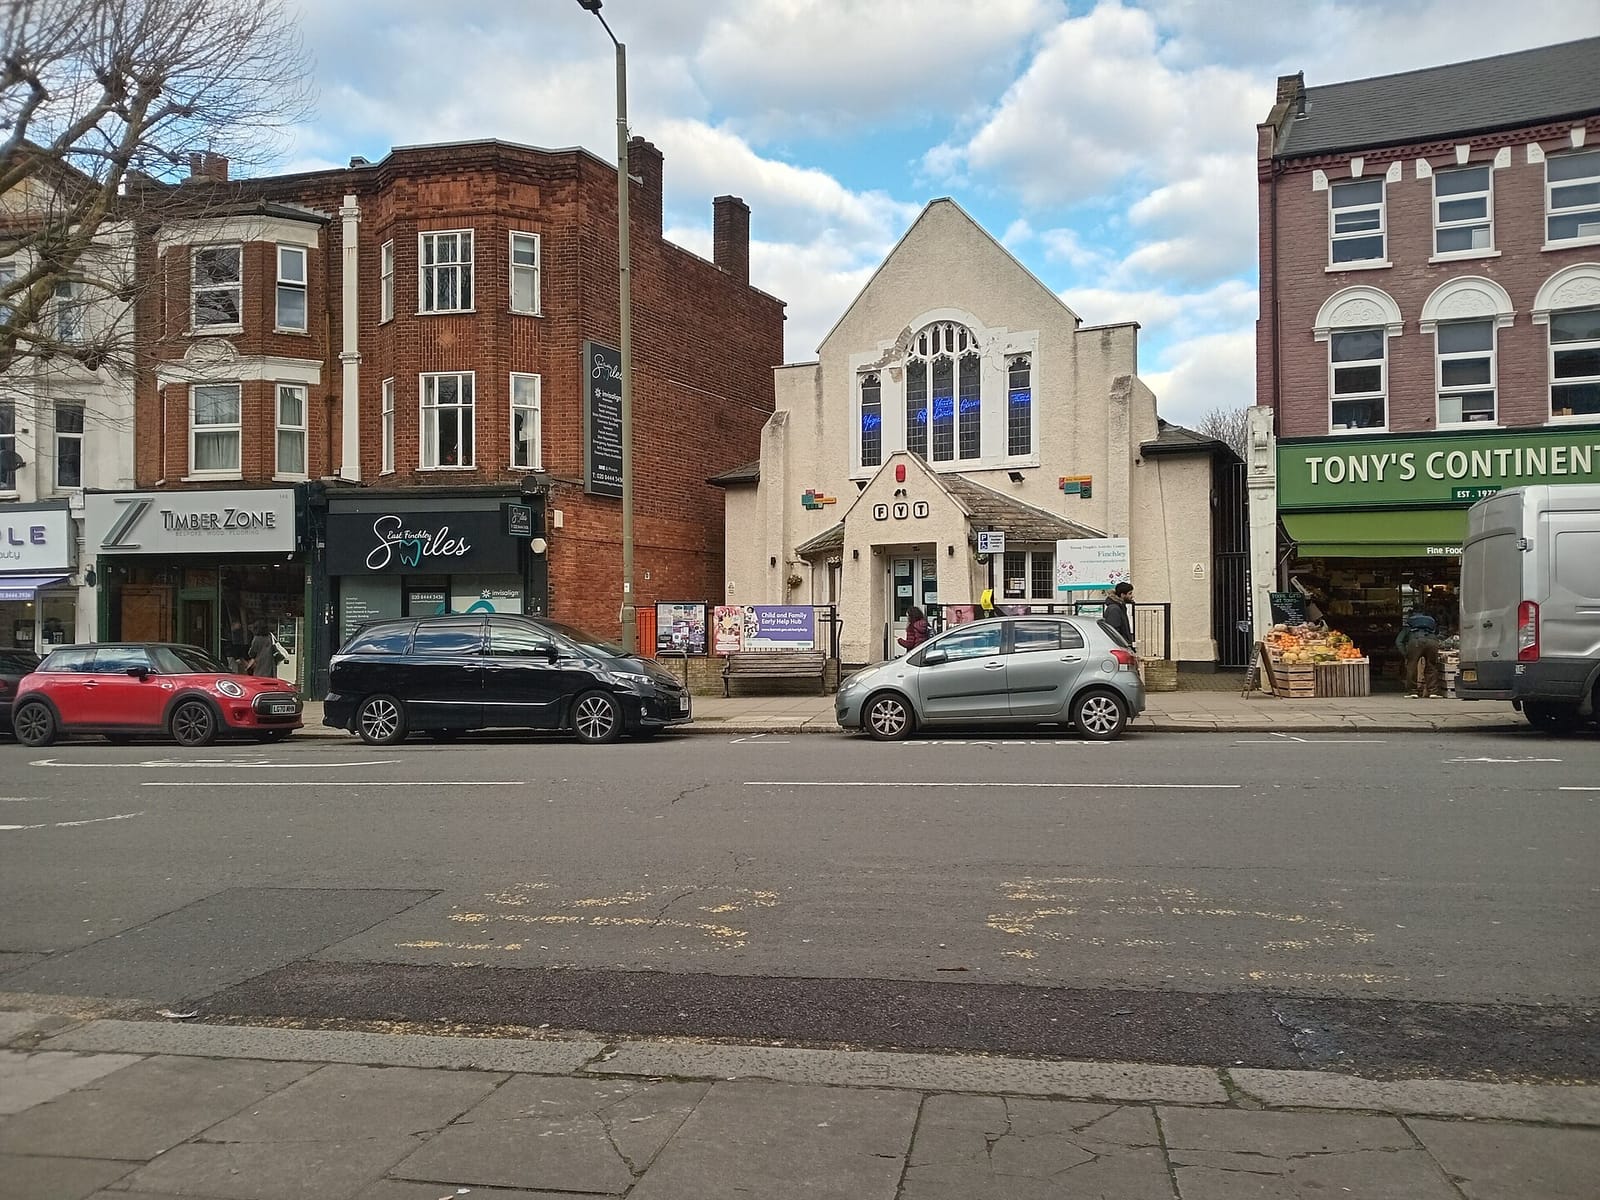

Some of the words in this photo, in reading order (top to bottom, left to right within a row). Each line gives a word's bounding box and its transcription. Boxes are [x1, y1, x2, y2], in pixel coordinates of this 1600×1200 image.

[1305, 453, 1416, 484] TONY'S
[160, 510, 221, 531] TIMBER
[223, 508, 276, 530] ZONE
[0, 525, 46, 546] LE
[387, 530, 403, 540] East
[404, 530, 432, 542] Finchley
[1098, 550, 1126, 558] Finchley
[1426, 546, 1444, 555] Fine
